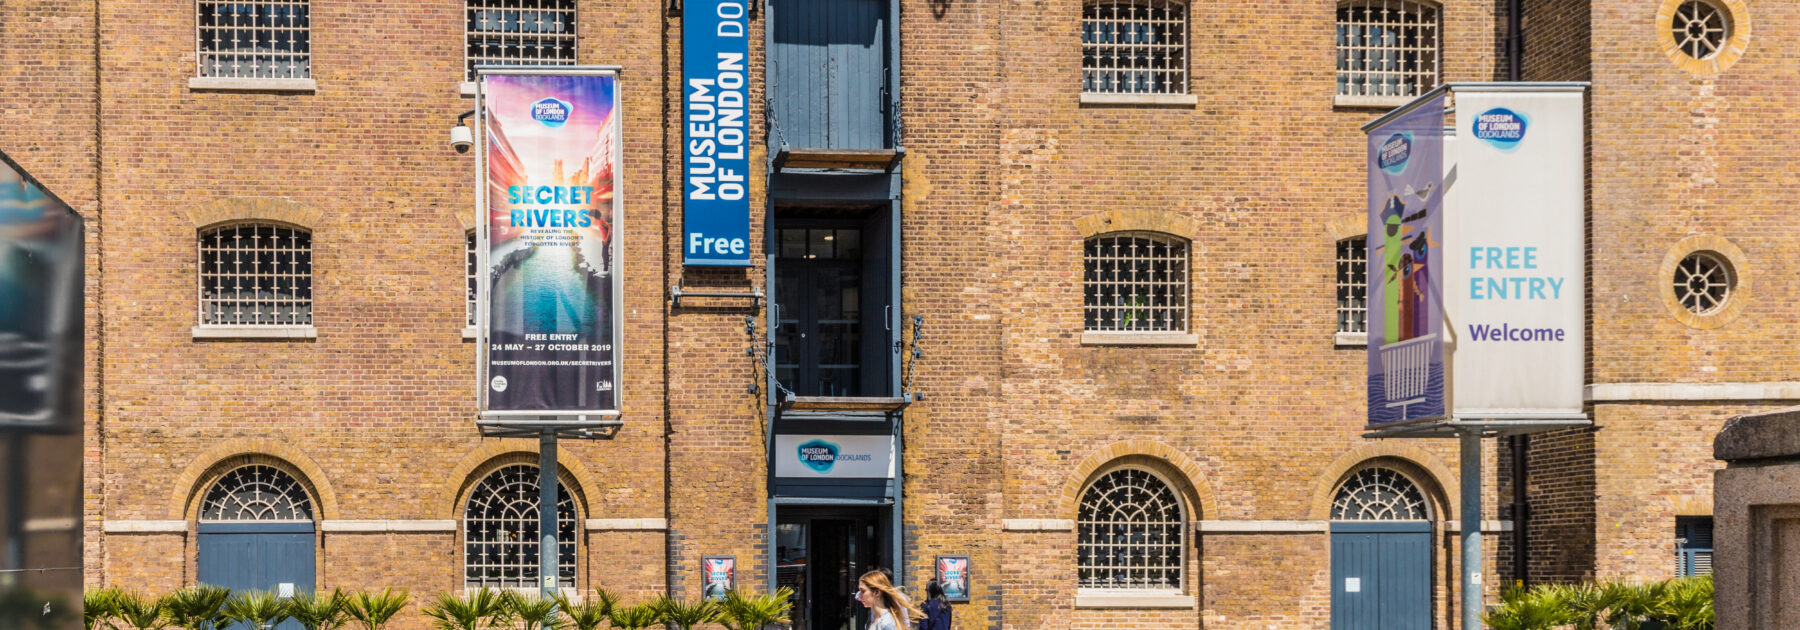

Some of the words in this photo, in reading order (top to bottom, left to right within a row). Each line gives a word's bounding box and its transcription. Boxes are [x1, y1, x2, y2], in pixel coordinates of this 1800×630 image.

[717, 52, 744, 159] LONDON
[1478, 113, 1514, 123] MUSEUM
[1478, 122, 1488, 130] OF
[1489, 122, 1521, 130] LONDON
[689, 78, 716, 200] MUSEUM
[1478, 130, 1521, 139] DOCKLANDS
[1382, 138, 1403, 153] MUSEUM
[1388, 143, 1408, 158] LONDON
[717, 167, 744, 200] OF
[507, 185, 595, 205] SECRET
[510, 208, 592, 228] RIVERS
[689, 232, 746, 255] Free
[1470, 246, 1538, 270] FREE
[1470, 276, 1565, 300] ENTRY
[525, 333, 548, 341] FREE
[550, 333, 578, 341] ENTRY
[1468, 322, 1566, 342] Welcome
